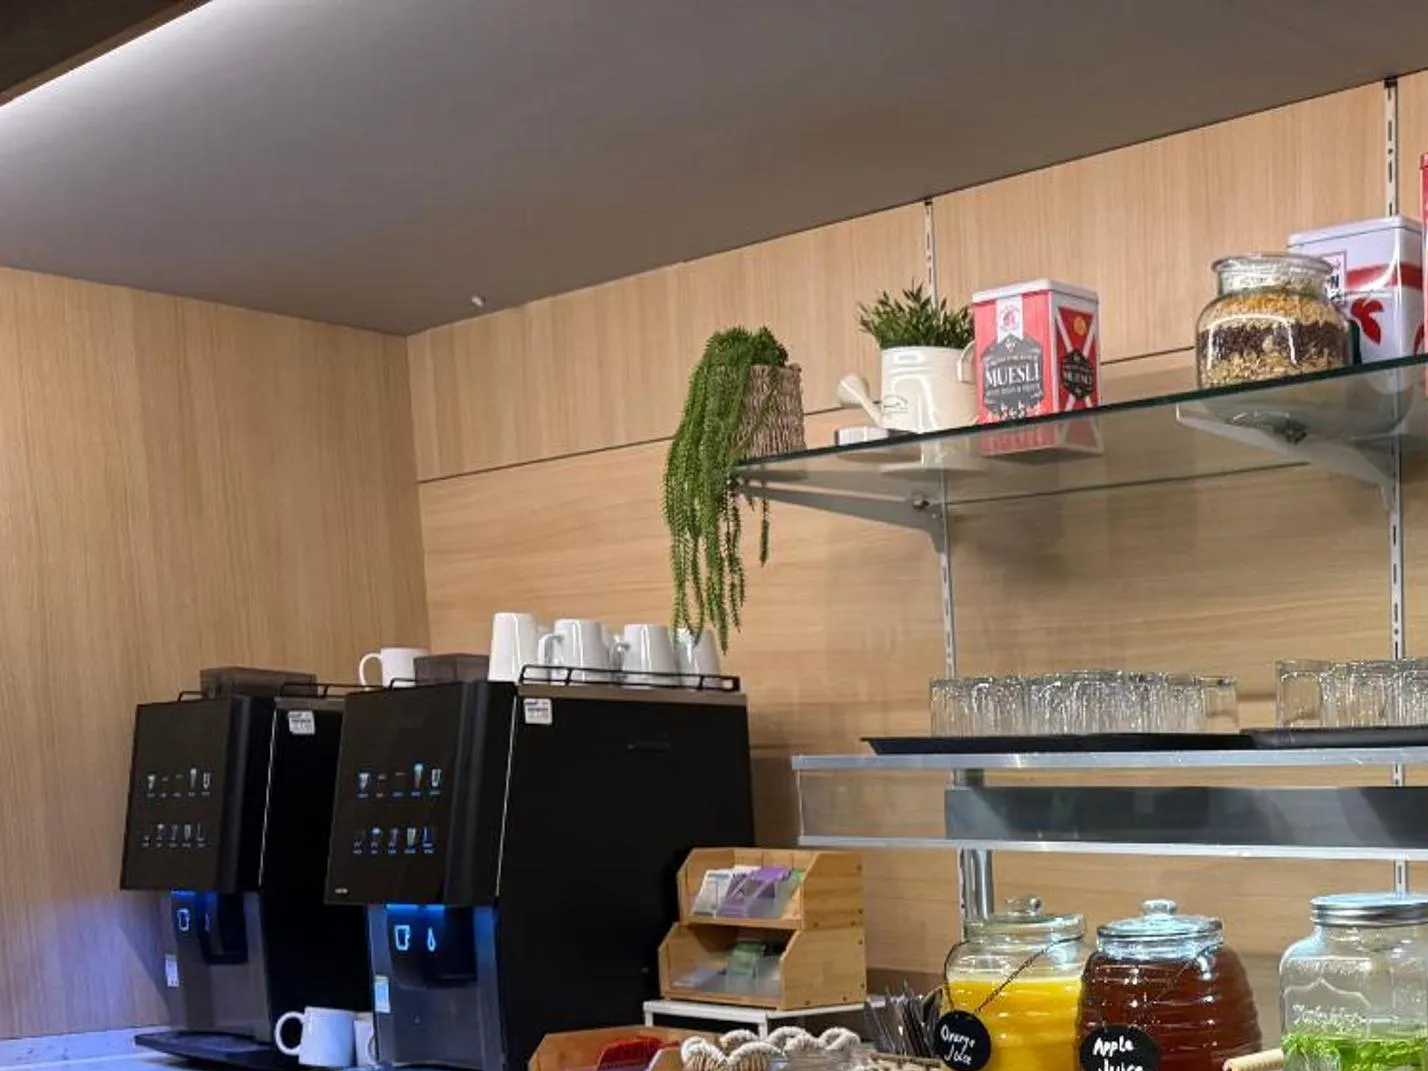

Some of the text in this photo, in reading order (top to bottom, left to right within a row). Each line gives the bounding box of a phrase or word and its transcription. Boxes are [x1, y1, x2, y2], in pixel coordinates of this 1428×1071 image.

[985, 361, 1040, 388] MUESLI
[940, 1023, 976, 1056] Orange
[1093, 1035, 1135, 1058] Apple
